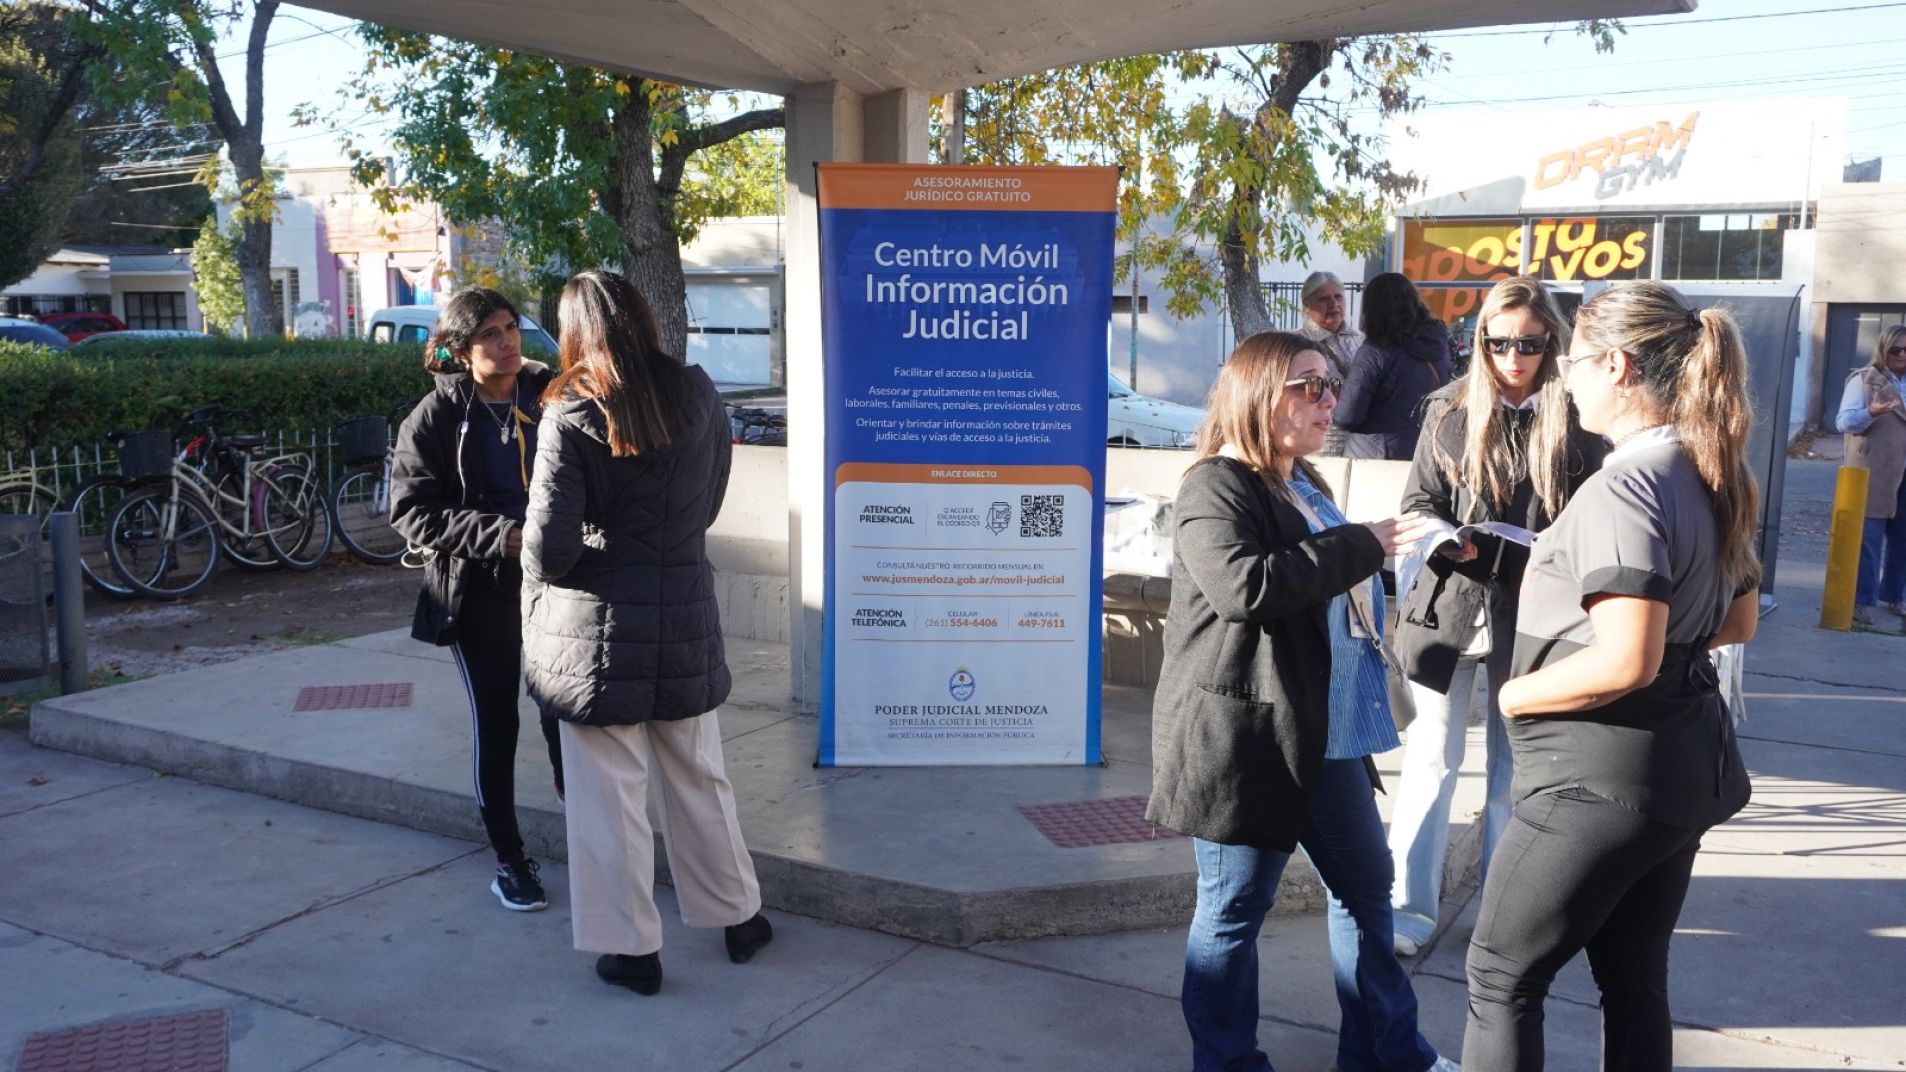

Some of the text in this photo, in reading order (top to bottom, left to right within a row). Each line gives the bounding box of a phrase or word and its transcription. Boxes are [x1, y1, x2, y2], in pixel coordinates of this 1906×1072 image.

[1595, 149, 1687, 200] GYM
[914, 177, 1022, 188] ASESORAMIENTO
[904, 189, 1031, 202] JURÍDICO GRATUITO
[874, 241, 1059, 269] Centro Móvil
[866, 273, 1068, 305] Información
[902, 309, 1028, 340] Judicial
[894, 367, 933, 377] Facilitar
[934, 368, 944, 377] el
[945, 370, 979, 378] acceso
[988, 369, 997, 378] la
[997, 369, 1035, 380] justicia.
[868, 386, 911, 396] Asesorar
[912, 387, 981, 398] gratuitamente
[997, 389, 1026, 398] temas
[1027, 388, 1060, 399] civiles,
[891, 399, 941, 410] familiares,
[943, 401, 981, 411] penales,
[983, 401, 1047, 412] previsionales
[1048, 404, 1055, 413] y
[1055, 402, 1083, 411] otros.
[856, 418, 1072, 430] Orientar y brindar información sobre trámites
[875, 431, 919, 442] judiciales
[921, 434, 928, 443] y
[929, 432, 948, 441] vías
[949, 433, 961, 442] de
[963, 434, 995, 442] acceso
[1005, 433, 1014, 442] la
[1015, 433, 1051, 444] justicia.
[931, 470, 997, 478] ENLACE DIRECTO
[863, 504, 911, 515] ATENCIÓN
[859, 514, 915, 525] PRESENCIAL
[916, 562, 950, 570] NUESTRO
[862, 573, 1065, 586] www.jusmendoza.gob.ar/movil-judicial
[856, 607, 902, 618] ATENCIÓN
[851, 617, 907, 628] TELEFÓNICA
[925, 618, 998, 628] (261) 554-6406
[1018, 618, 1065, 628] 449-7611
[875, 705, 1048, 715] PODER JUDICIAL MENDOZA
[889, 718, 1034, 727] SUPREMA CORTE DE JUSTICIA
